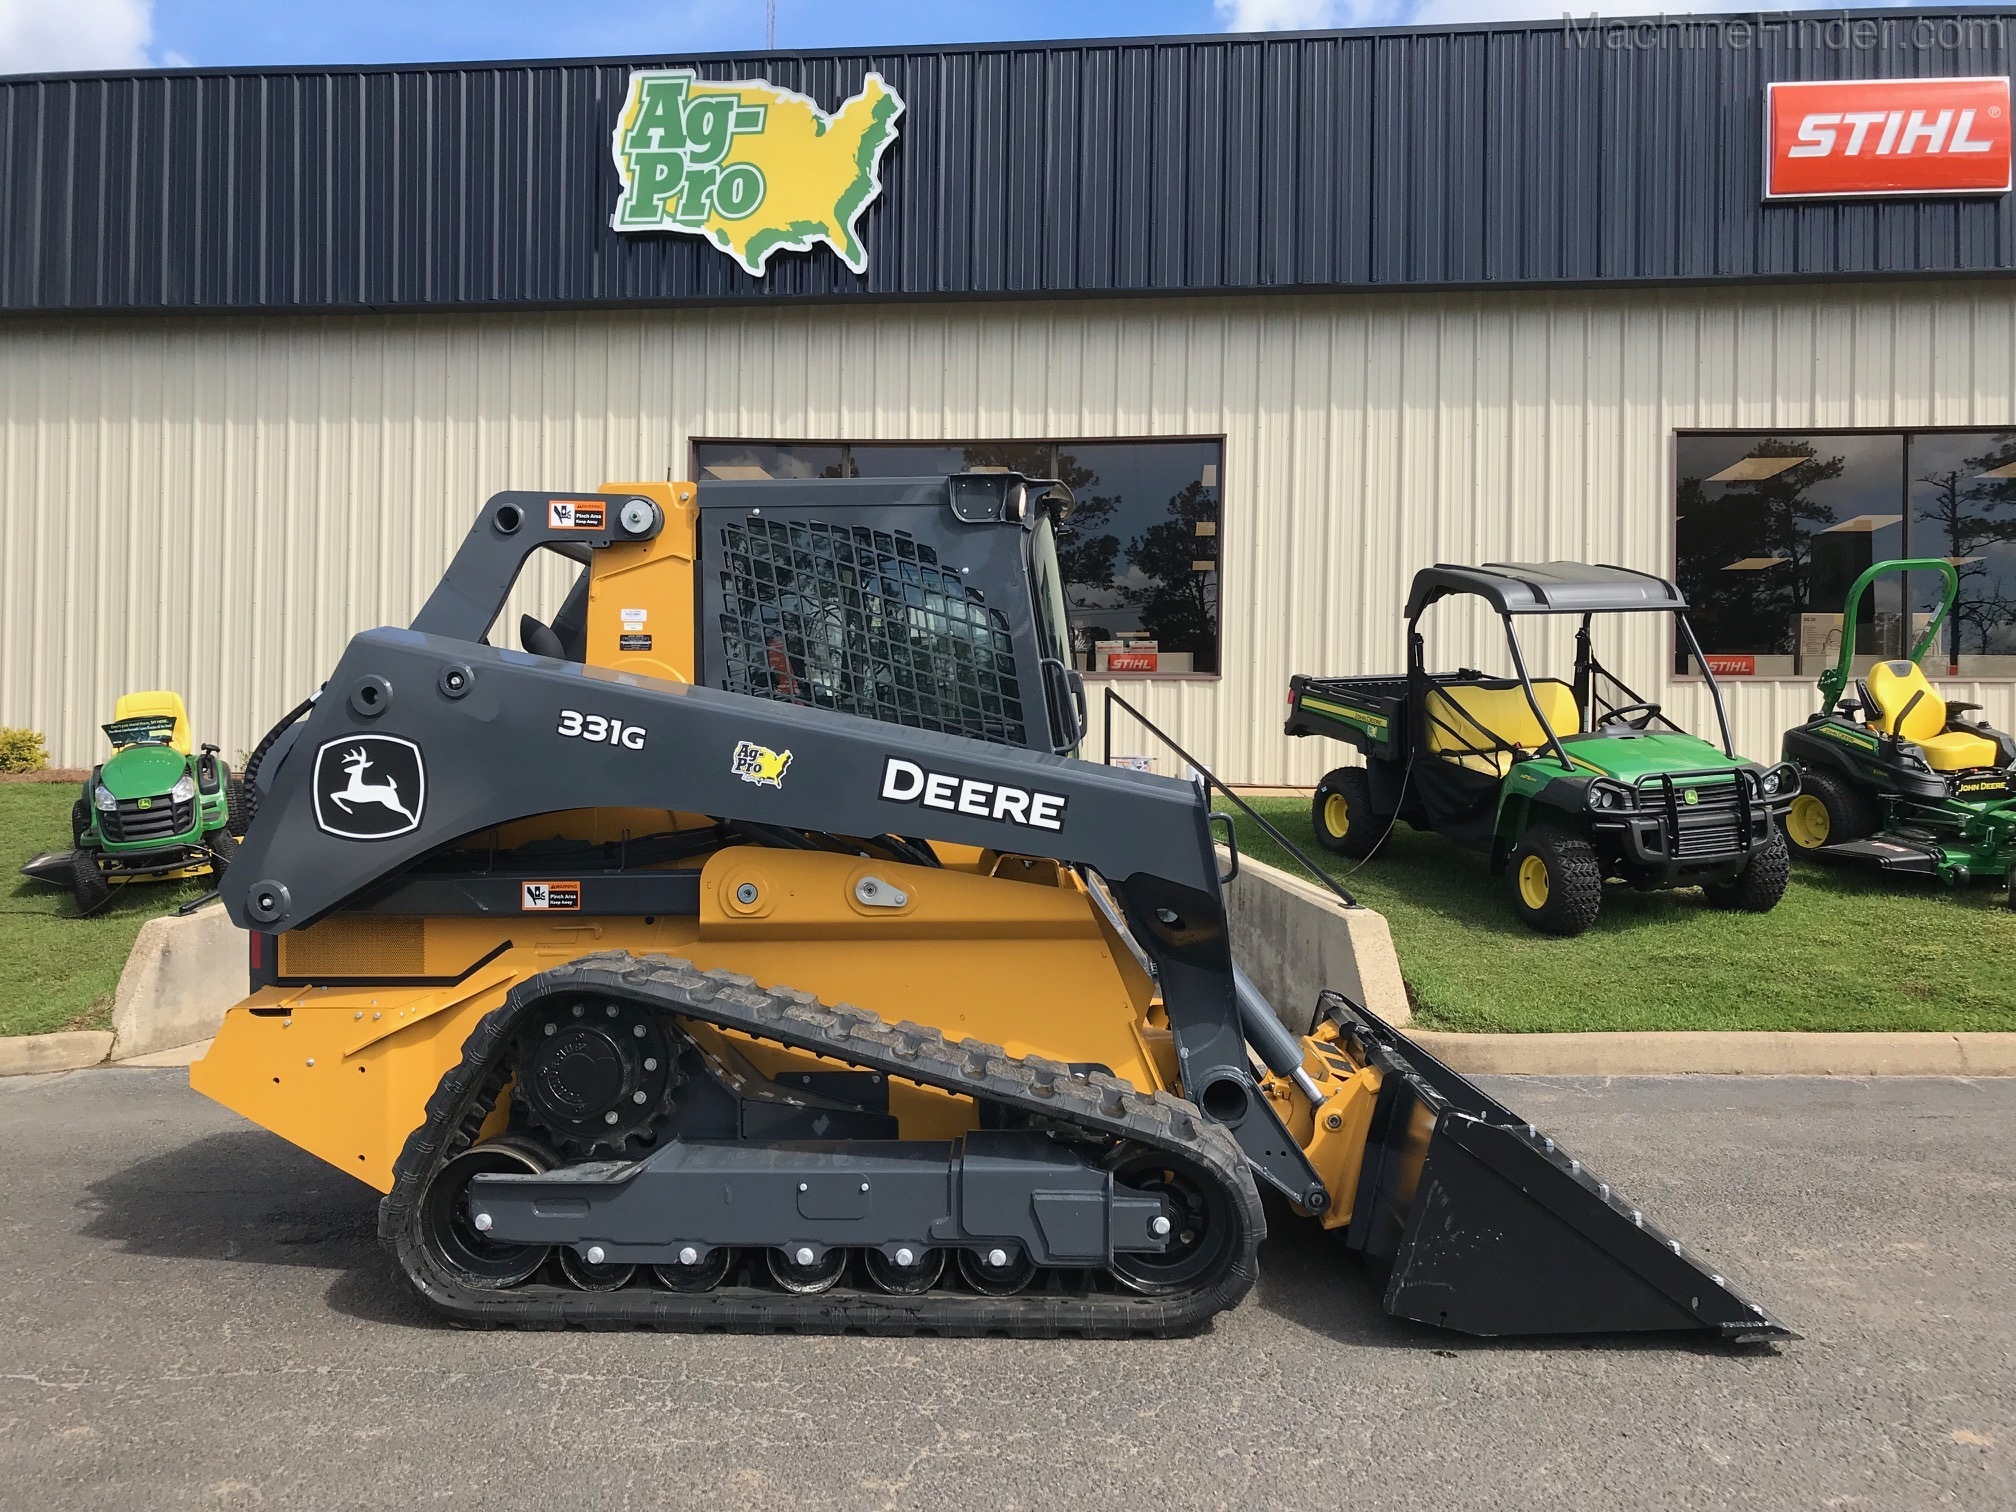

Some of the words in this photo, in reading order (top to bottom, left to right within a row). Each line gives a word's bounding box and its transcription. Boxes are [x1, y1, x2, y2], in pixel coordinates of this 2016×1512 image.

[624, 77, 766, 165] Ag-
[1788, 109, 1993, 158] STIHL
[623, 152, 765, 222] Pro
[1111, 659, 1152, 669] STIHL
[1709, 661, 1750, 672] STIHL
[1353, 713, 1367, 722] JOHN
[1367, 716, 1383, 726] DEERE
[557, 709, 647, 751] 331G
[737, 744, 764, 761] Ag-
[735, 758, 762, 773] Pro
[881, 757, 1067, 831] DEERE
[1958, 784, 1980, 792] JOHN
[1980, 782, 2007, 790] DEERE
